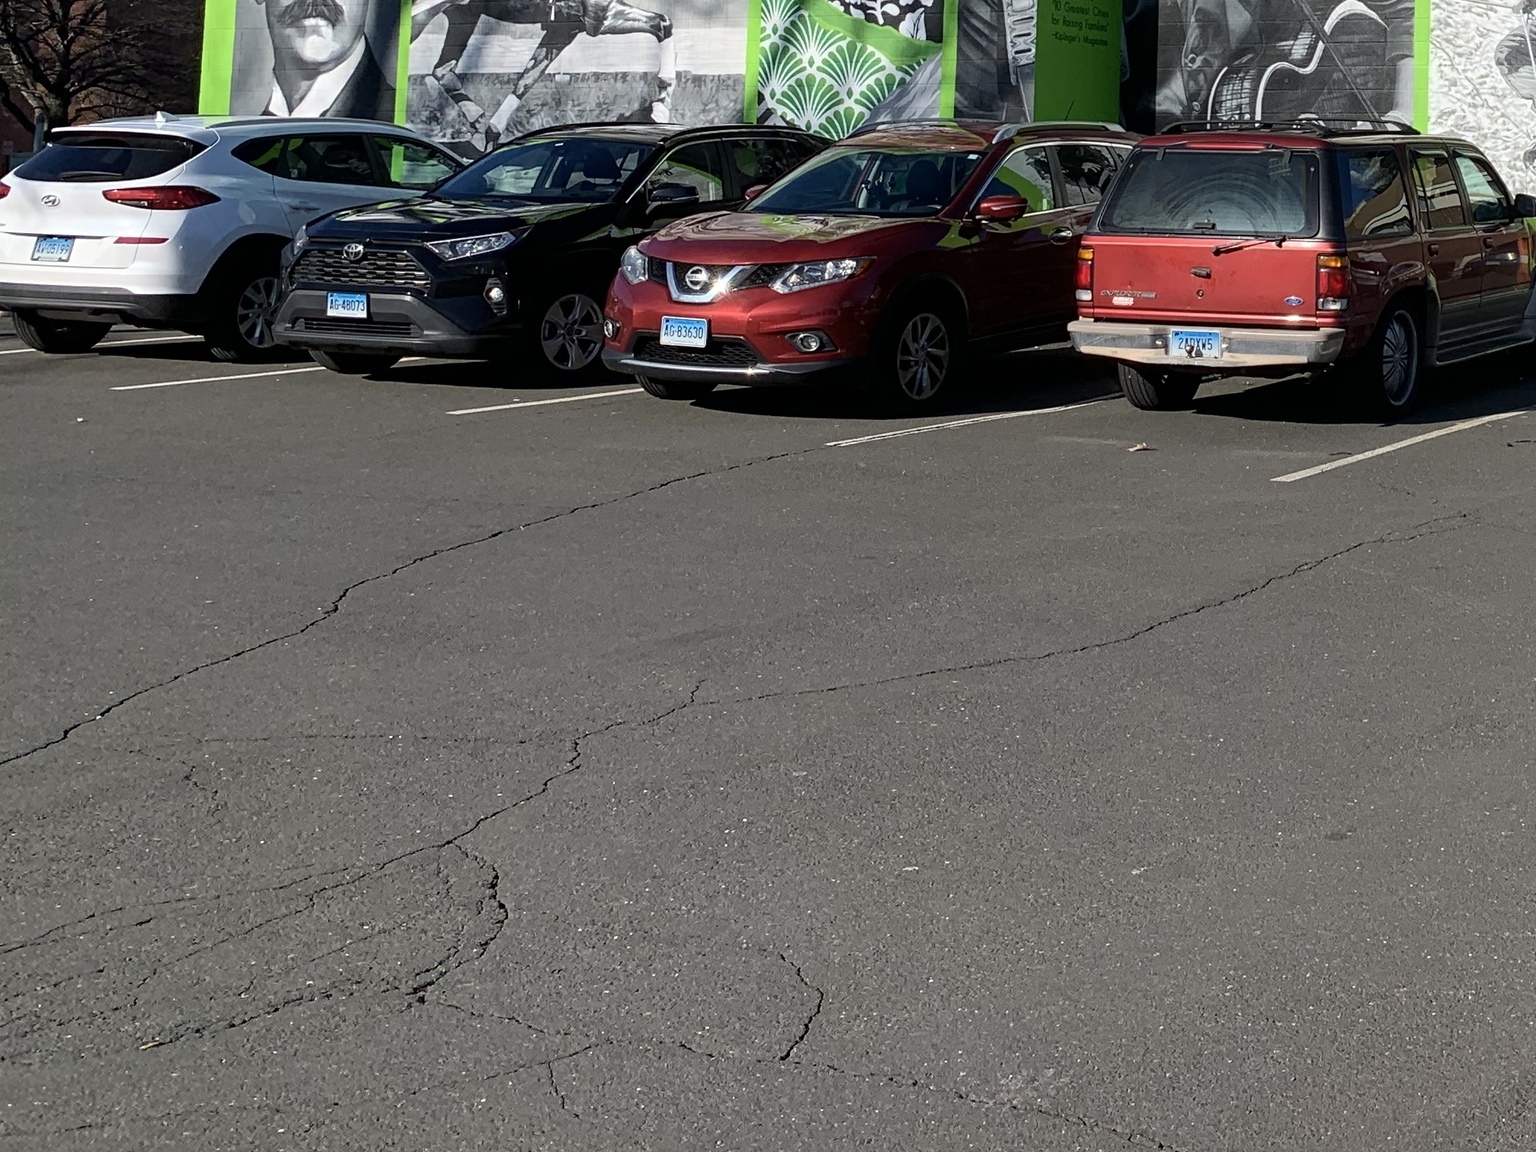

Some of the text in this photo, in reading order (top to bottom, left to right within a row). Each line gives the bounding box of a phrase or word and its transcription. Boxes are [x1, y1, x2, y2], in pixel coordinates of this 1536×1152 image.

[1064, 1, 1089, 15] Greatest
[1093, 6, 1109, 18] Cities
[1051, 13, 1060, 25] for
[1063, 16, 1082, 31] Raising
[1083, 35, 1108, 47] Magazine
